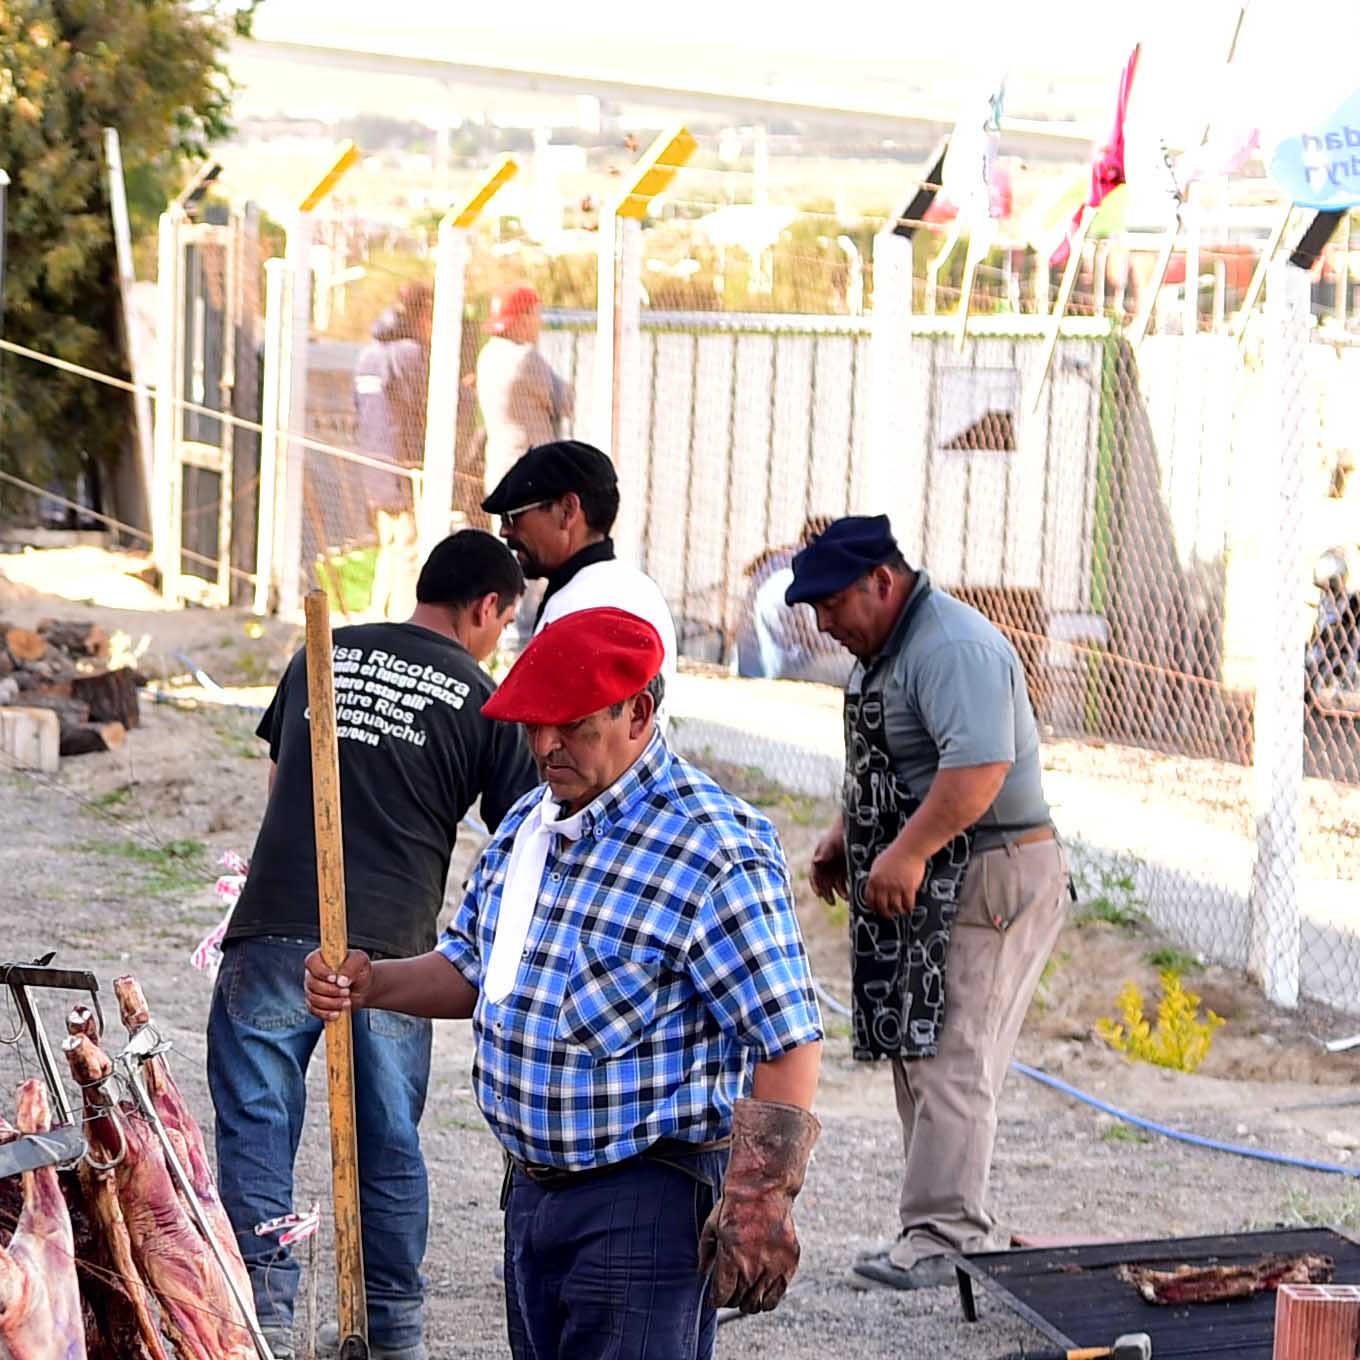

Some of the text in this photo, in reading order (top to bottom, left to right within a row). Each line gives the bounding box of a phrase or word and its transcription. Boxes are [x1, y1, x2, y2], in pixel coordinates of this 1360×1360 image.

[333, 645, 470, 697] isa Ricotera
[360, 662, 376, 677] el
[376, 666, 418, 689] fuego
[417, 681, 465, 711] crezca
[335, 690, 373, 708] ntre
[365, 681, 403, 703] estar
